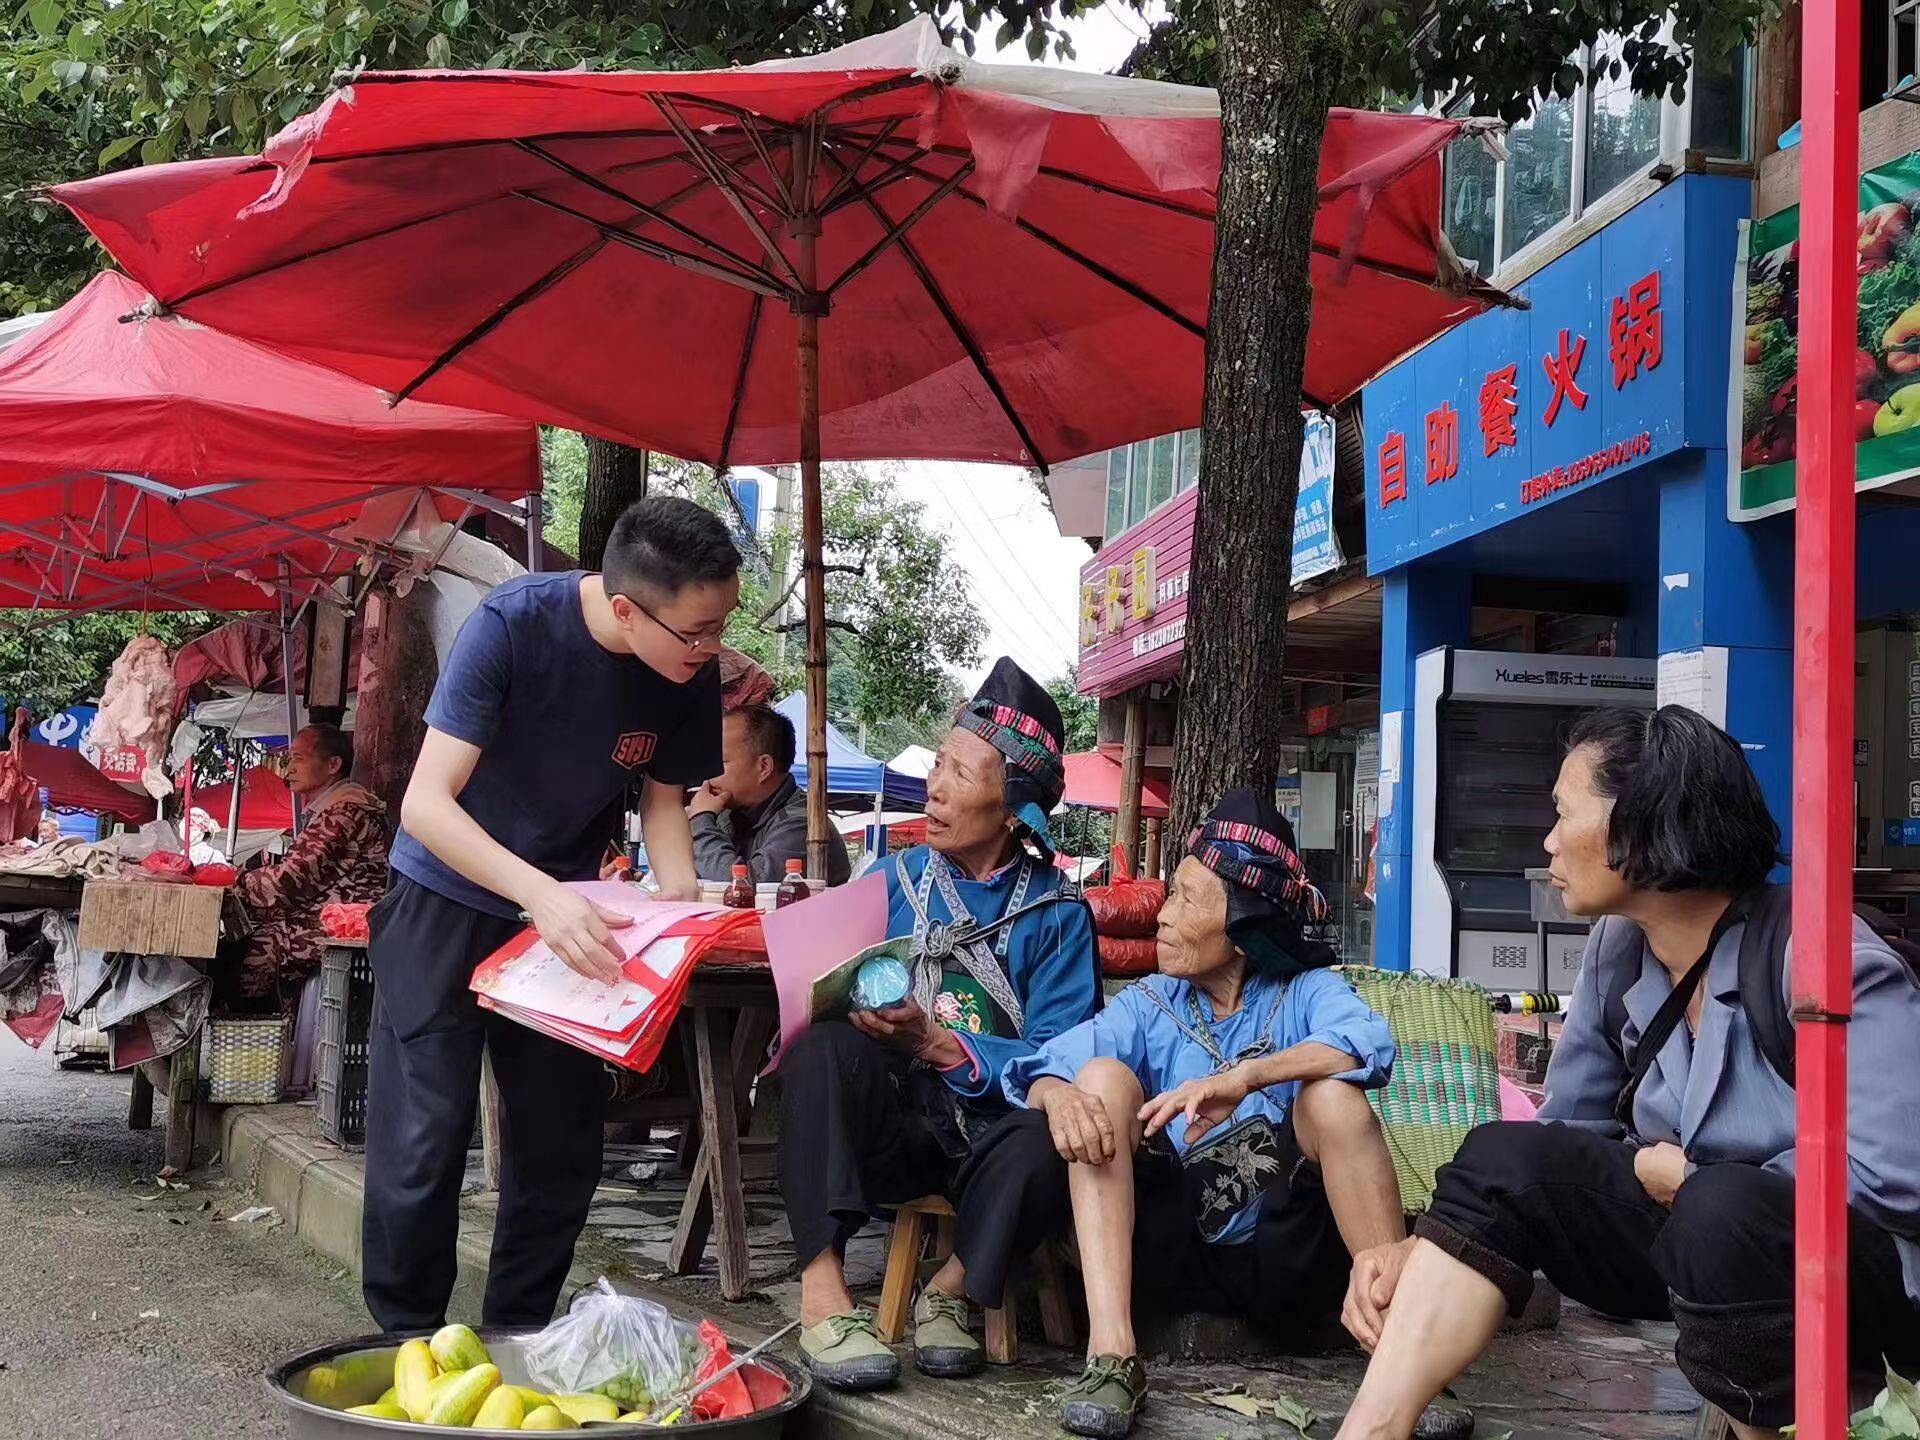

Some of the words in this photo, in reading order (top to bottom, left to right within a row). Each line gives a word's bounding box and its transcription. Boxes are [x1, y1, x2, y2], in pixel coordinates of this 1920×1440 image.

[1379, 269, 1662, 509] 自助餐火锅
